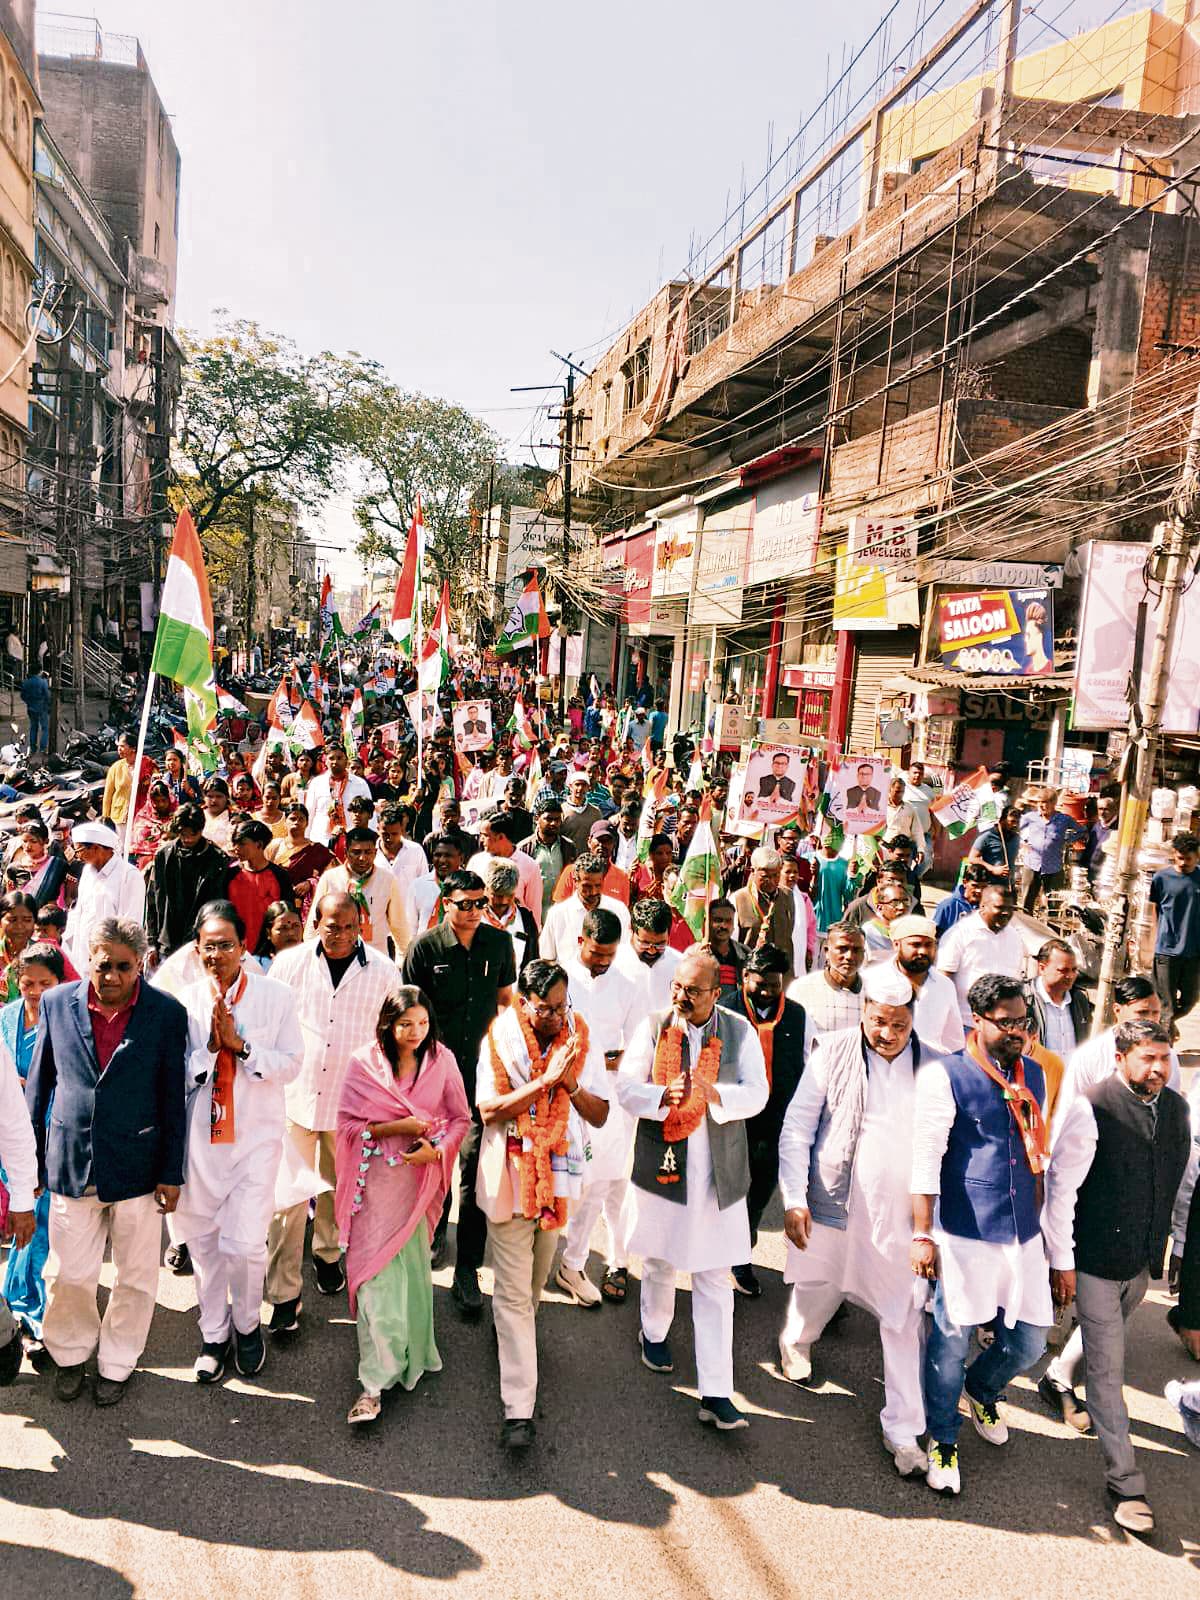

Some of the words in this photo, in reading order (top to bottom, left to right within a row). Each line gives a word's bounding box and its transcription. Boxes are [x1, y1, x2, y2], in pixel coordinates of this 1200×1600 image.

[858, 547, 912, 559] JEWELLERS
[974, 564, 1040, 587] SALOON
[948, 597, 982, 616] TATA
[943, 608, 1007, 641] SALOON
